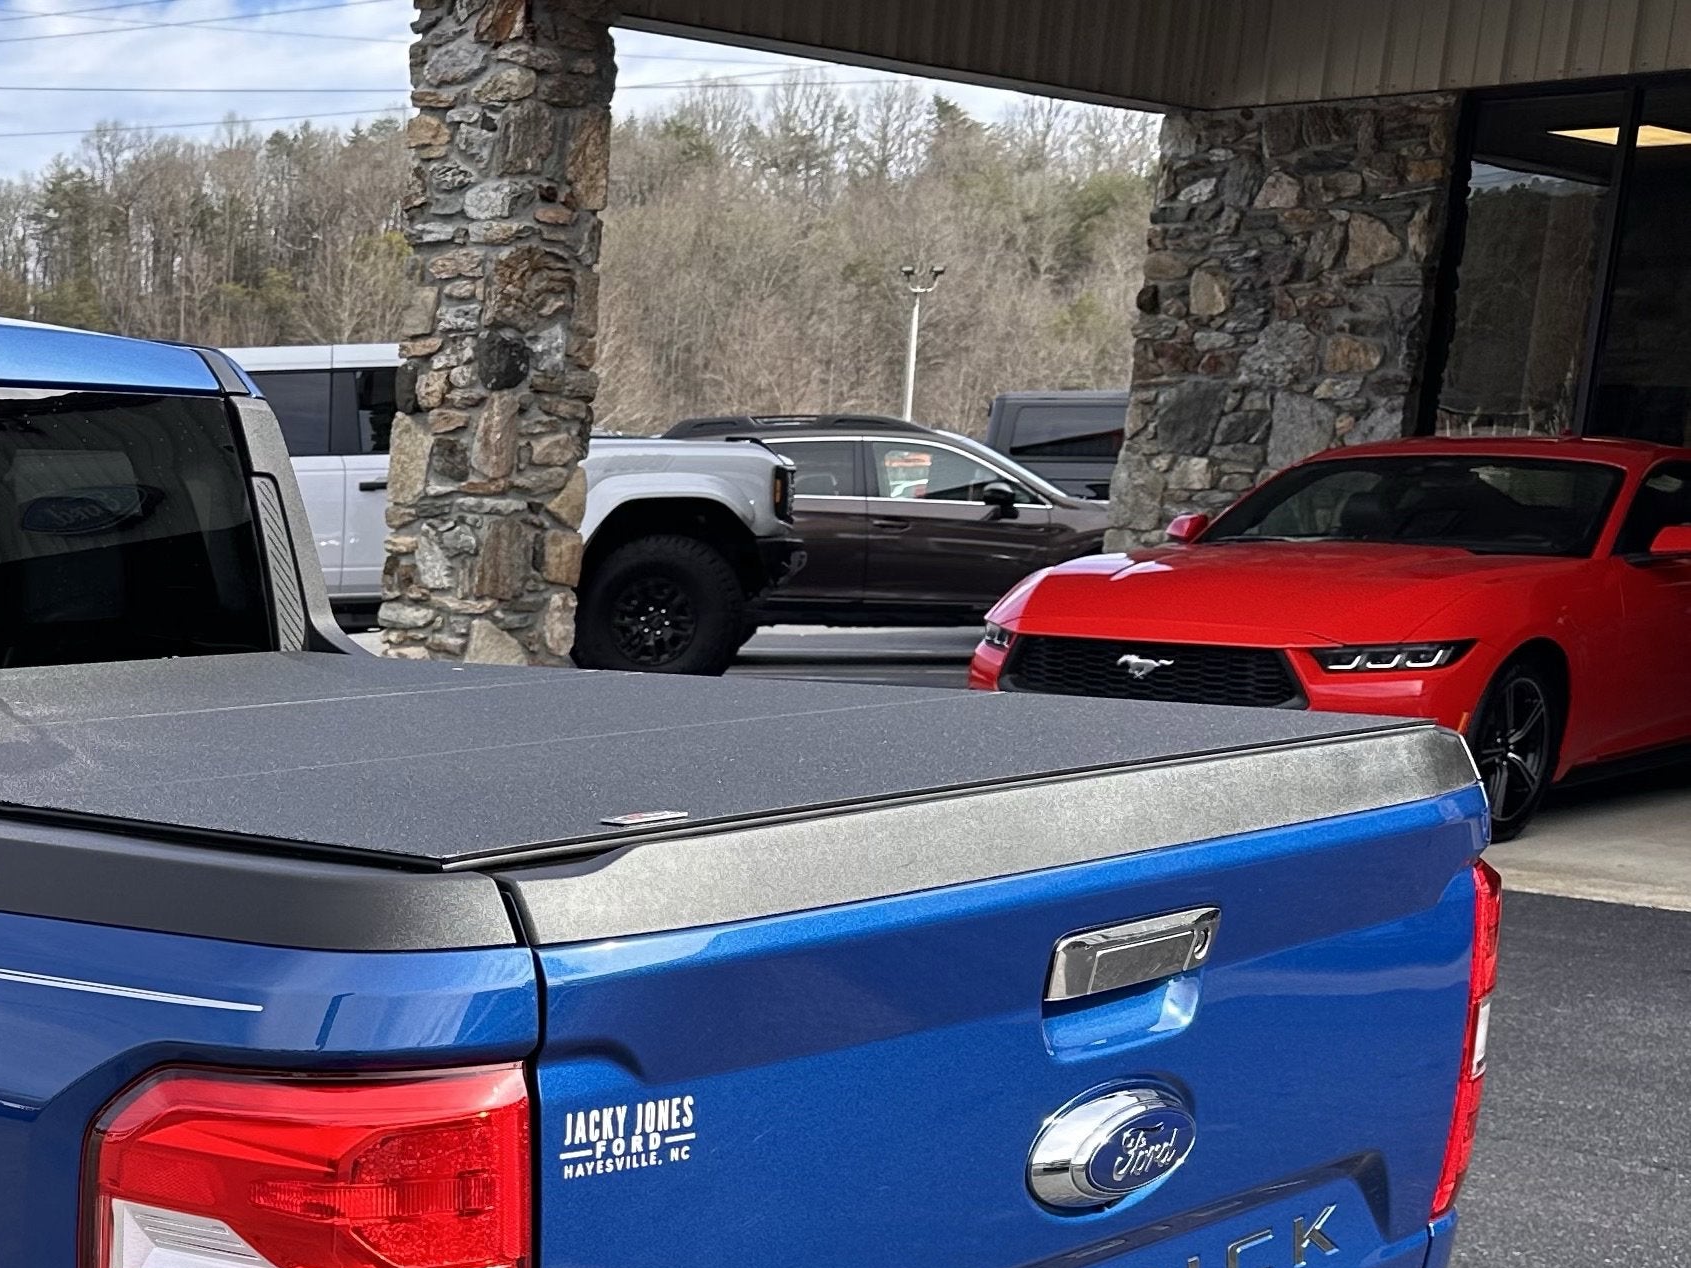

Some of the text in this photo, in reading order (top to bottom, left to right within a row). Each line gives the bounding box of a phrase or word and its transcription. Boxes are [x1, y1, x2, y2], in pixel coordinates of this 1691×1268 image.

[564, 1095, 695, 1146] JACKY JONES
[563, 1145, 691, 1180] HAYESVILLE, NC
[595, 1132, 662, 1159] FORD
[1112, 1121, 1178, 1181] Ford
